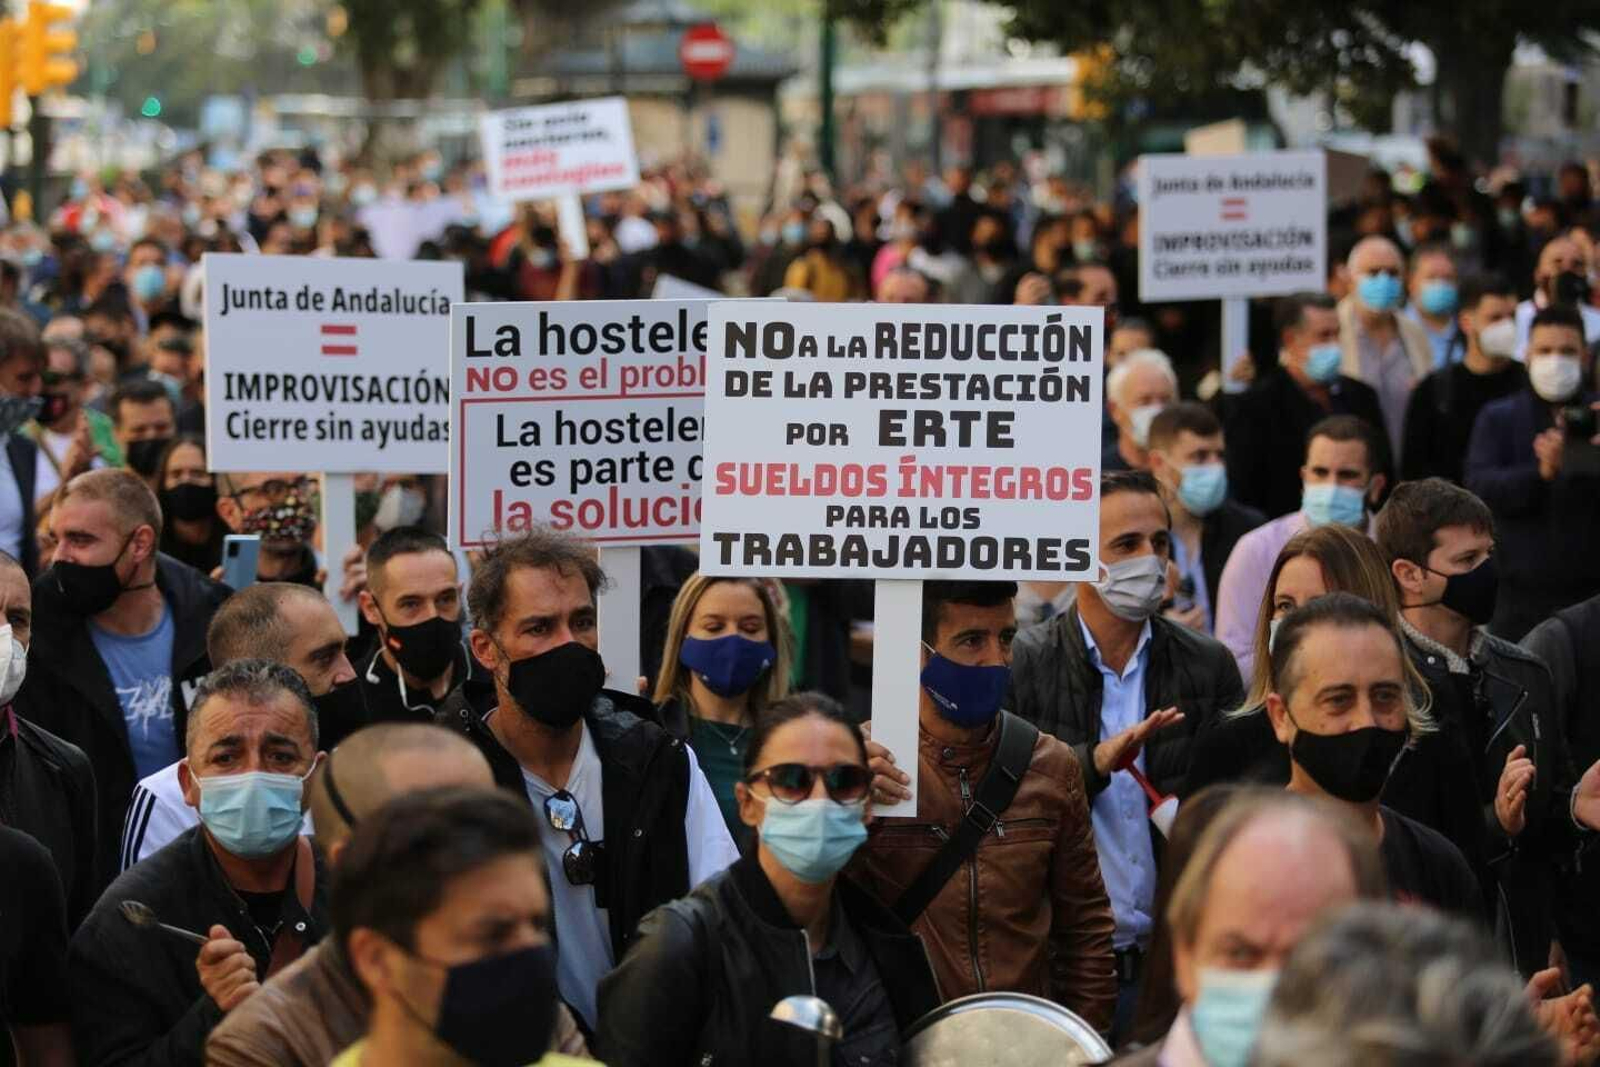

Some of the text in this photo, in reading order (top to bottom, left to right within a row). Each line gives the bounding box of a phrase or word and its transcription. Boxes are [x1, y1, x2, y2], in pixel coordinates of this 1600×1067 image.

[1153, 177, 1200, 197] Junta
[1206, 175, 1225, 193] de
[1154, 226, 1314, 252] IMPROVISACIÓN
[1154, 258, 1210, 280] Cierre
[1216, 258, 1241, 276] sin
[220, 283, 450, 316] Junta de Andalucía
[466, 316, 521, 358] La
[724, 313, 1092, 362] NO A LA REDUCCIÓN
[224, 369, 449, 405] IMPROVISACIÓN
[466, 366, 519, 392] NO
[528, 367, 568, 390] es
[579, 357, 608, 389] el
[724, 366, 1091, 402] DE LA PRESTACIÓN
[226, 409, 448, 450] Cierre sin ayudas
[497, 414, 541, 447] La
[785, 409, 1015, 449] POR ERTE
[510, 459, 555, 487] es
[570, 451, 674, 494] parte
[715, 454, 1093, 501] SUELDOS ÍNTEGROS
[493, 489, 532, 532] la
[825, 505, 981, 530] PARA LOS
[713, 532, 1091, 572] TRABAJADORES
